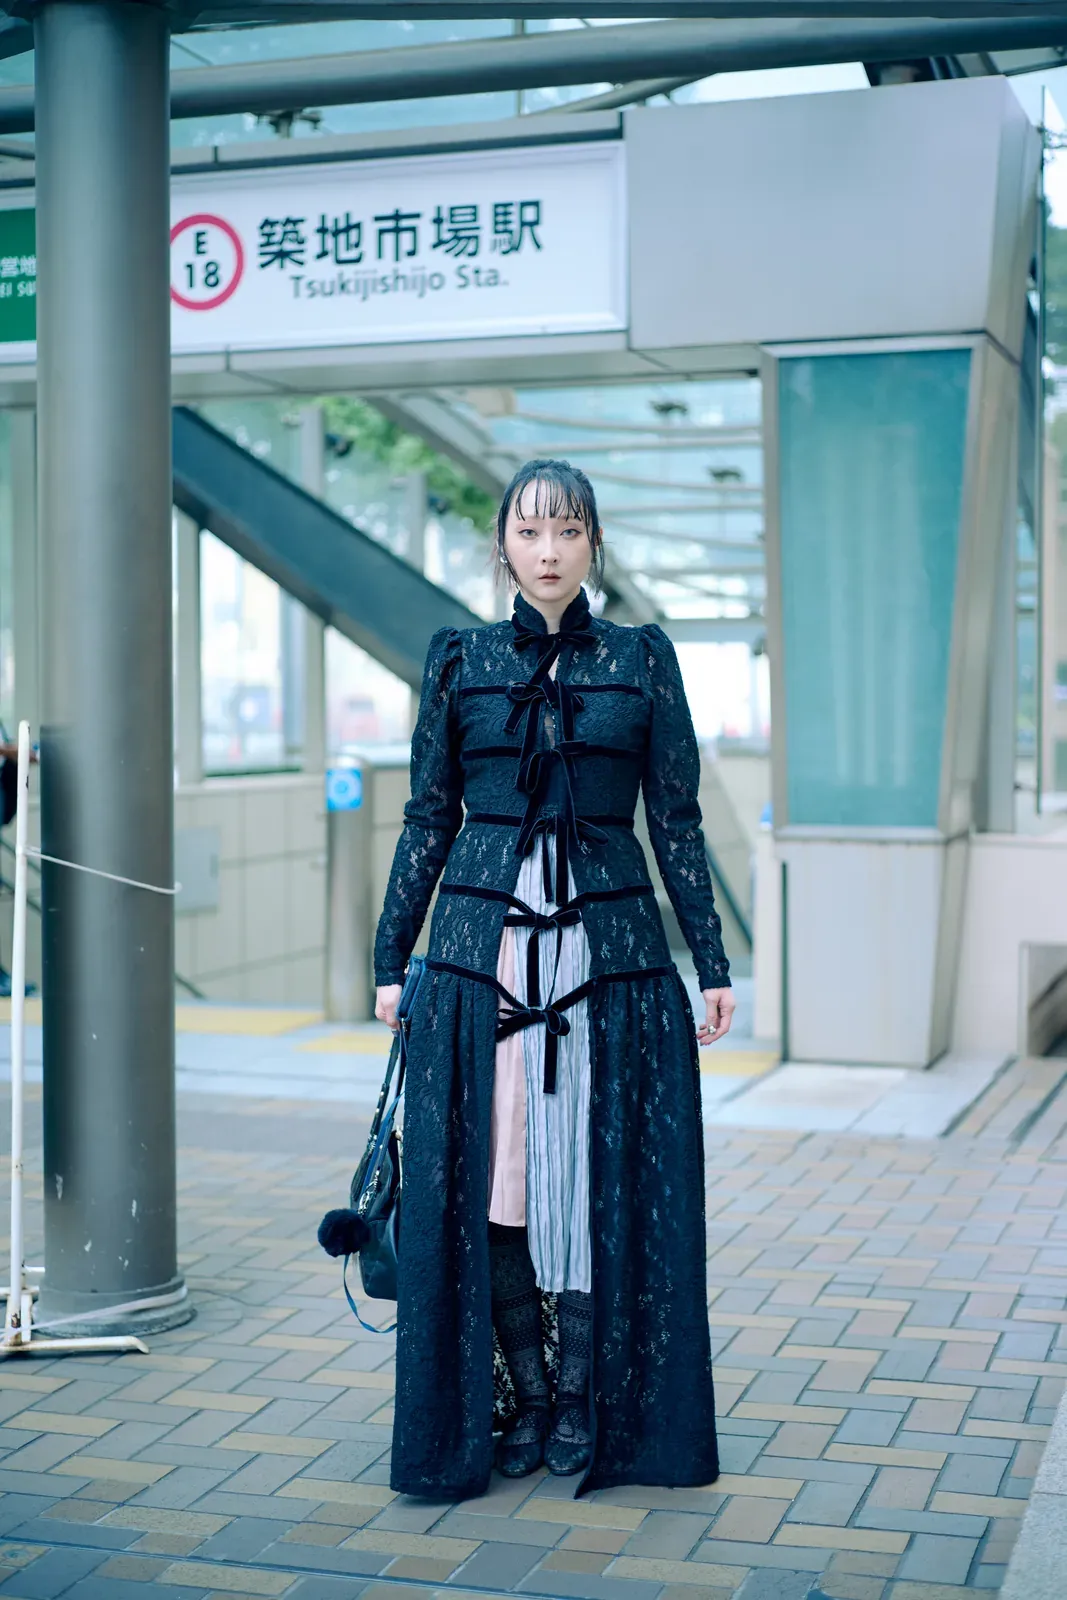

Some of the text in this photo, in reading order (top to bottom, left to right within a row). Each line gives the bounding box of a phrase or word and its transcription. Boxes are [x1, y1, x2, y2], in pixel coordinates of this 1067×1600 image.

[196, 231, 206, 255] E
[258, 200, 543, 269] 築地市場駅
[186, 261, 219, 288] 18
[289, 264, 510, 301] Tsukijishijo Sta.
